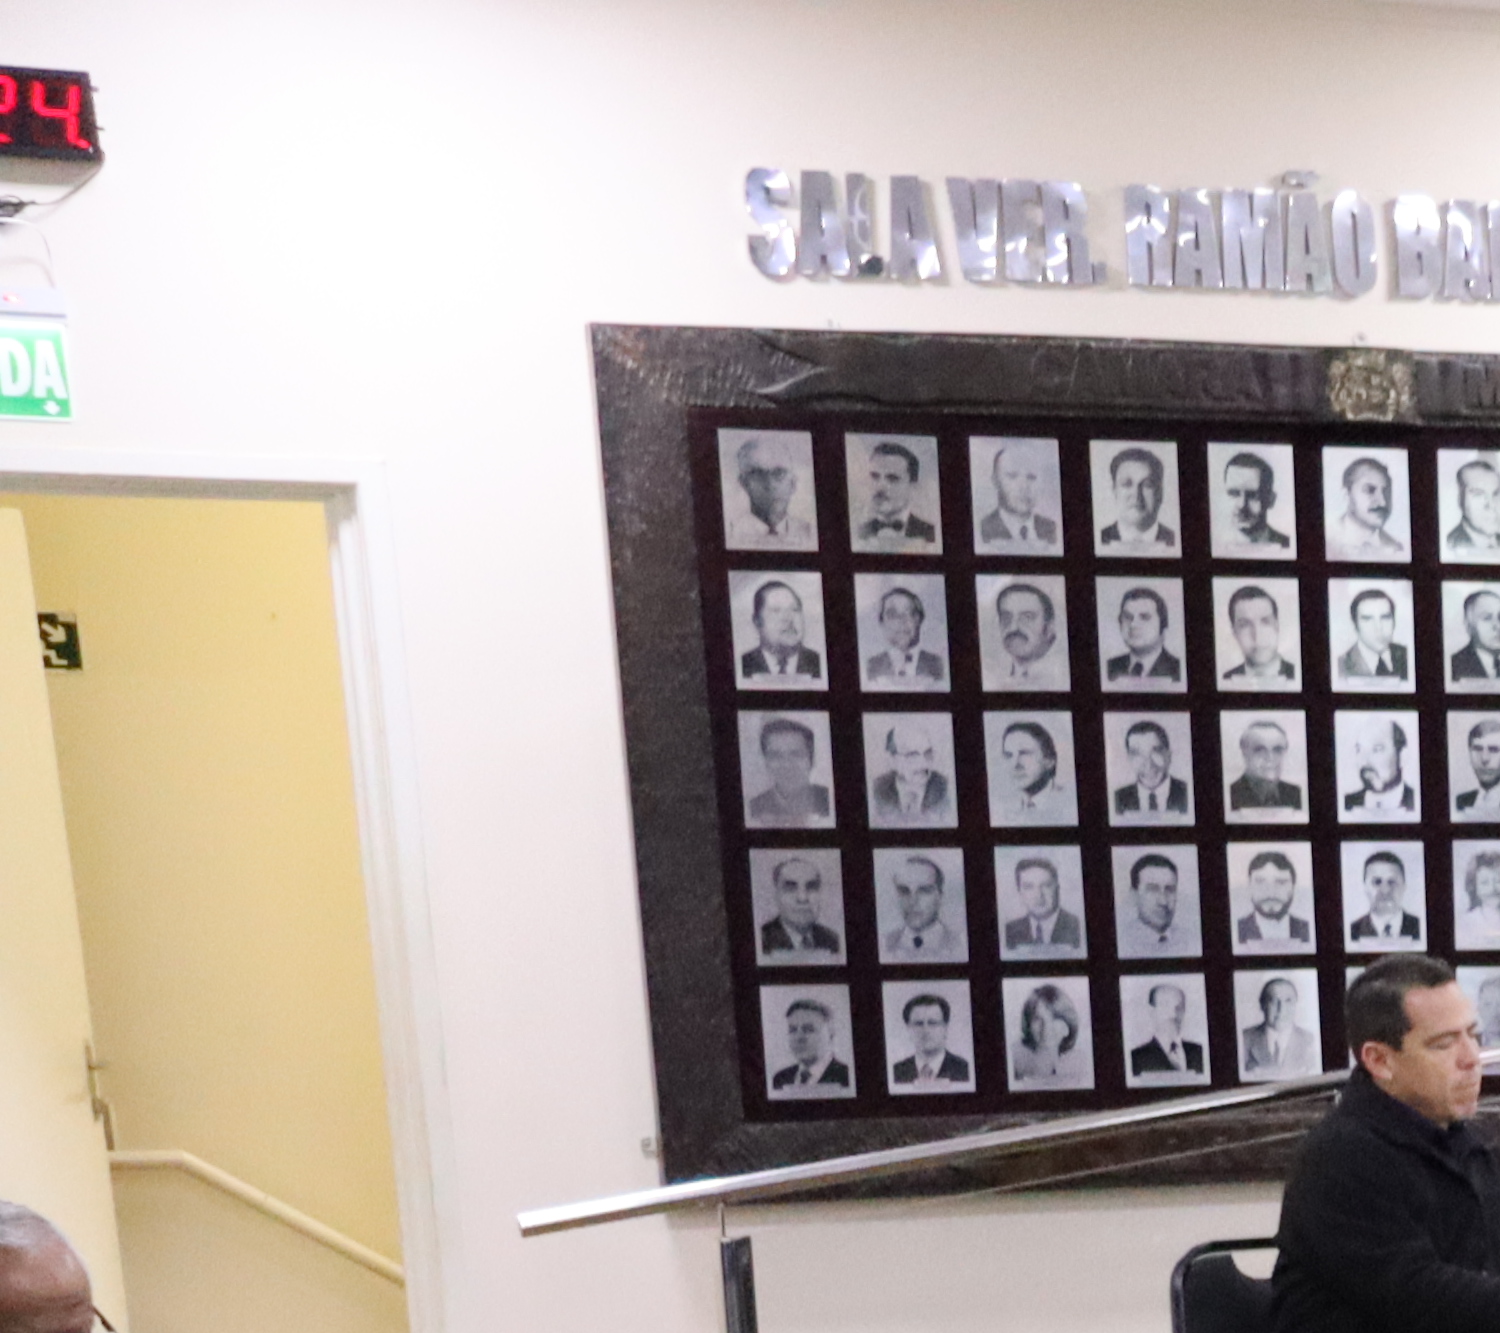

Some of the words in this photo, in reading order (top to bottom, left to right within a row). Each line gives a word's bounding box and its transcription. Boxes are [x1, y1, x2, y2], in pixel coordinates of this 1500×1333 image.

[746, 168, 942, 283] SALA
[946, 177, 1107, 284] VER.
[1125, 170, 1377, 300] RAMÃO
